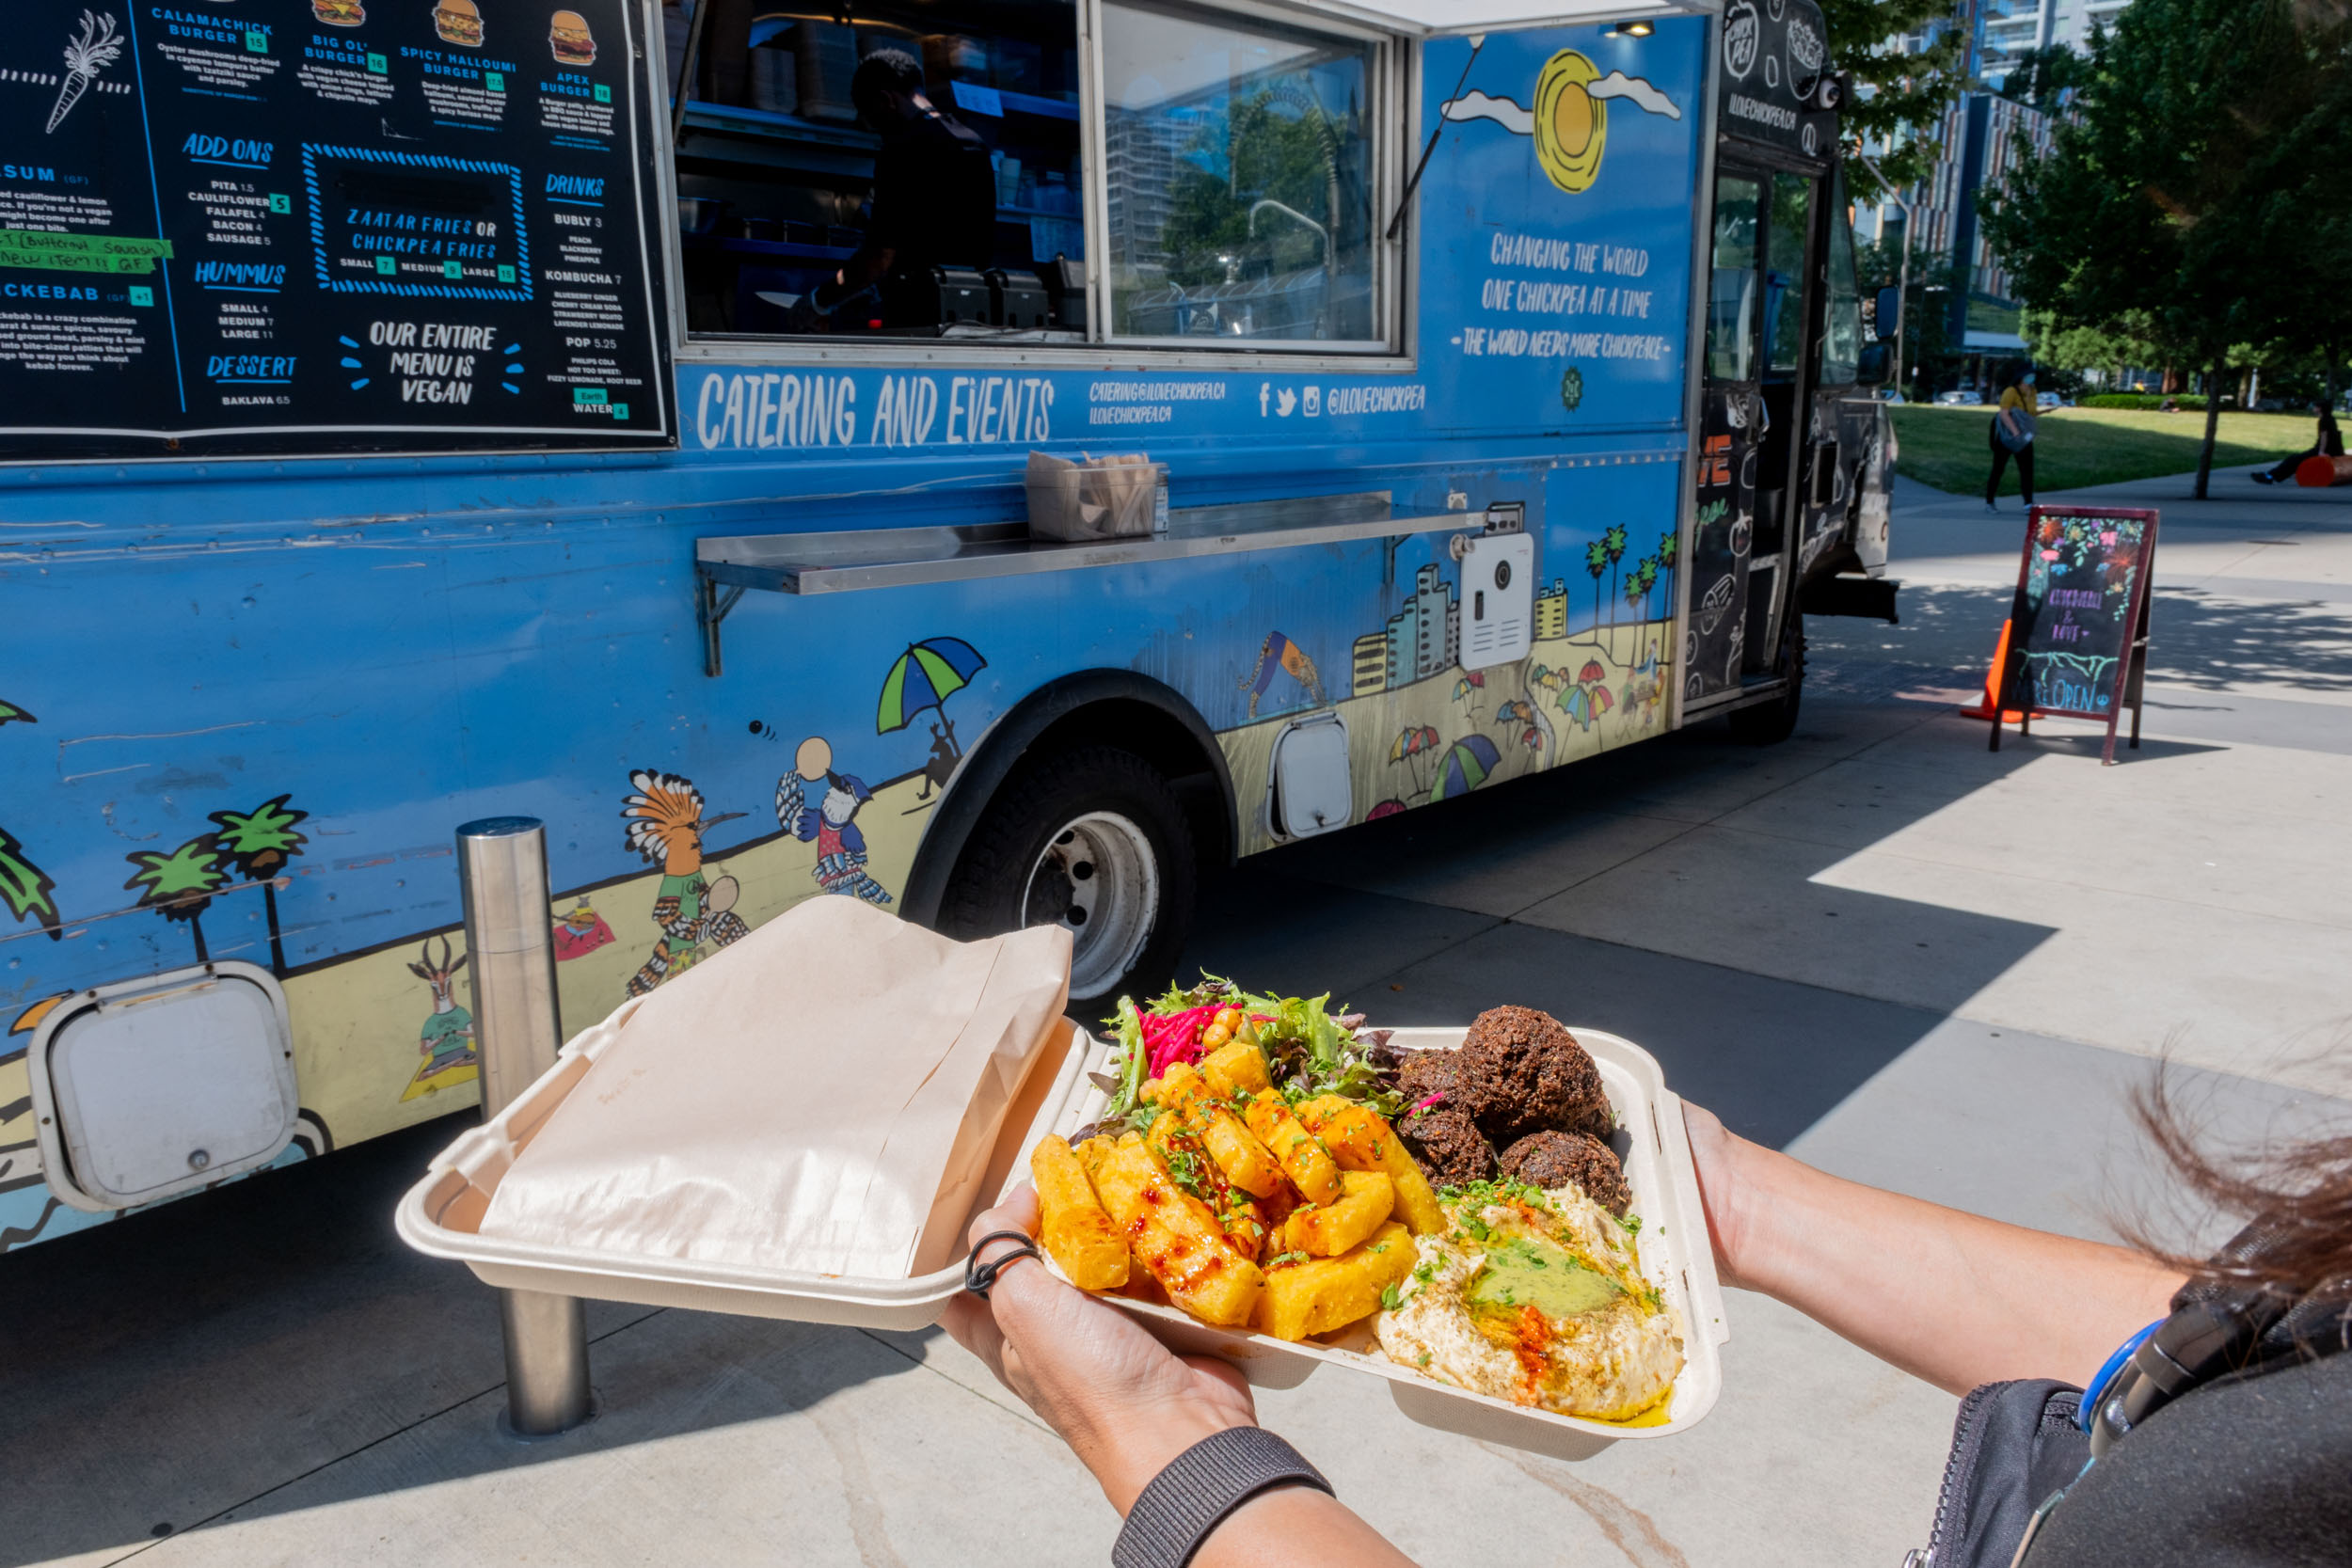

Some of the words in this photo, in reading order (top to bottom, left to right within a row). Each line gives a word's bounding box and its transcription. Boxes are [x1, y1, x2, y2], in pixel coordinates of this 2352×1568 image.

[151, 8, 273, 36] CALAMACHICK
[169, 24, 237, 44] BURGER
[312, 34, 340, 49] BIG
[157, 42, 186, 54] Oyster
[188, 48, 236, 61] mushrooms
[304, 46, 366, 66] BURGER
[400, 46, 442, 62] SPICY
[448, 54, 516, 72] HALLOUMI
[372, 59, 383, 69] 16
[423, 63, 479, 80] BURGER
[557, 71, 590, 86] APEX
[540, 82, 590, 98] BURGER
[182, 133, 229, 158] ADD
[231, 139, 274, 163] ONS
[0, 165, 55, 182] SUM
[211, 180, 238, 192] PITA
[546, 173, 605, 198] DRINKS
[14, 191, 67, 203] cauliflower
[188, 192, 271, 207] CAULIFLOWER
[26, 203, 56, 213] you're
[58, 205, 74, 214] not
[85, 208, 113, 216] vegan
[206, 206, 257, 219] FALAFEL
[259, 211, 265, 219] 4
[6, 221, 24, 230] just
[26, 222, 45, 230] one
[47, 223, 70, 232] bite.
[28, 213, 67, 223] become
[88, 217, 111, 226] after
[213, 220, 254, 231] BACON
[256, 224, 262, 232] 4
[422, 216, 472, 235] FRIES
[476, 221, 497, 238] OR
[553, 214, 592, 227] BUBLY
[596, 217, 602, 228] 3
[207, 232, 262, 245] SAUSAGE
[263, 237, 271, 245] 5
[352, 233, 442, 255] CHICKPEA
[447, 242, 497, 259] FRIES
[1490, 231, 1570, 271] CHANGING
[1574, 242, 1599, 274] THE
[1602, 245, 1648, 277] WORLD
[340, 258, 374, 269] SMALL
[383, 261, 389, 270] 7
[401, 262, 445, 274] MEDIUM
[195, 261, 286, 285] HUMMUS
[462, 267, 496, 277] LARGE
[545, 270, 612, 284] KOMBUCHA
[0, 283, 99, 301] CKEBAB
[1482, 278, 1515, 311] ONE
[1517, 280, 1587, 315] CHICKPEA
[1588, 285, 1607, 315] AT
[1607, 287, 1619, 316] A
[1621, 290, 1653, 319] TIME
[221, 304, 260, 313] SMALL
[262, 305, 268, 313] 4
[54, 315, 78, 324] crazy
[80, 315, 137, 325] combination
[218, 316, 265, 326] MEDIUM
[17, 333, 51, 342] ground
[221, 329, 260, 339] LARGE
[369, 321, 418, 347] OUR
[421, 323, 498, 351] ENTIRE
[565, 337, 591, 348] POP
[594, 339, 617, 349] 5.25
[1463, 327, 1486, 356] THE
[1487, 328, 1529, 356] WORLD
[1528, 331, 1569, 357] NEEDS
[1567, 332, 1601, 358] MORE
[206, 355, 297, 377] DESSERT
[389, 352, 453, 376] MENU
[454, 355, 476, 378] IS
[402, 379, 472, 404] VEGAN
[1089, 382, 1226, 403] CATERING@ILOVECHICKPEA.CA
[222, 396, 275, 405] BAKLAVA
[1327, 385, 1426, 415] @ILOVECHICKPEA
[573, 404, 613, 414] WATER
[696, 372, 857, 450] CATERING
[871, 374, 939, 448] AND
[946, 375, 1055, 445] EVENTS
[1089, 405, 1172, 425] ILOVECHICKPEA.CA
[2053, 679, 2096, 711] OPEN
